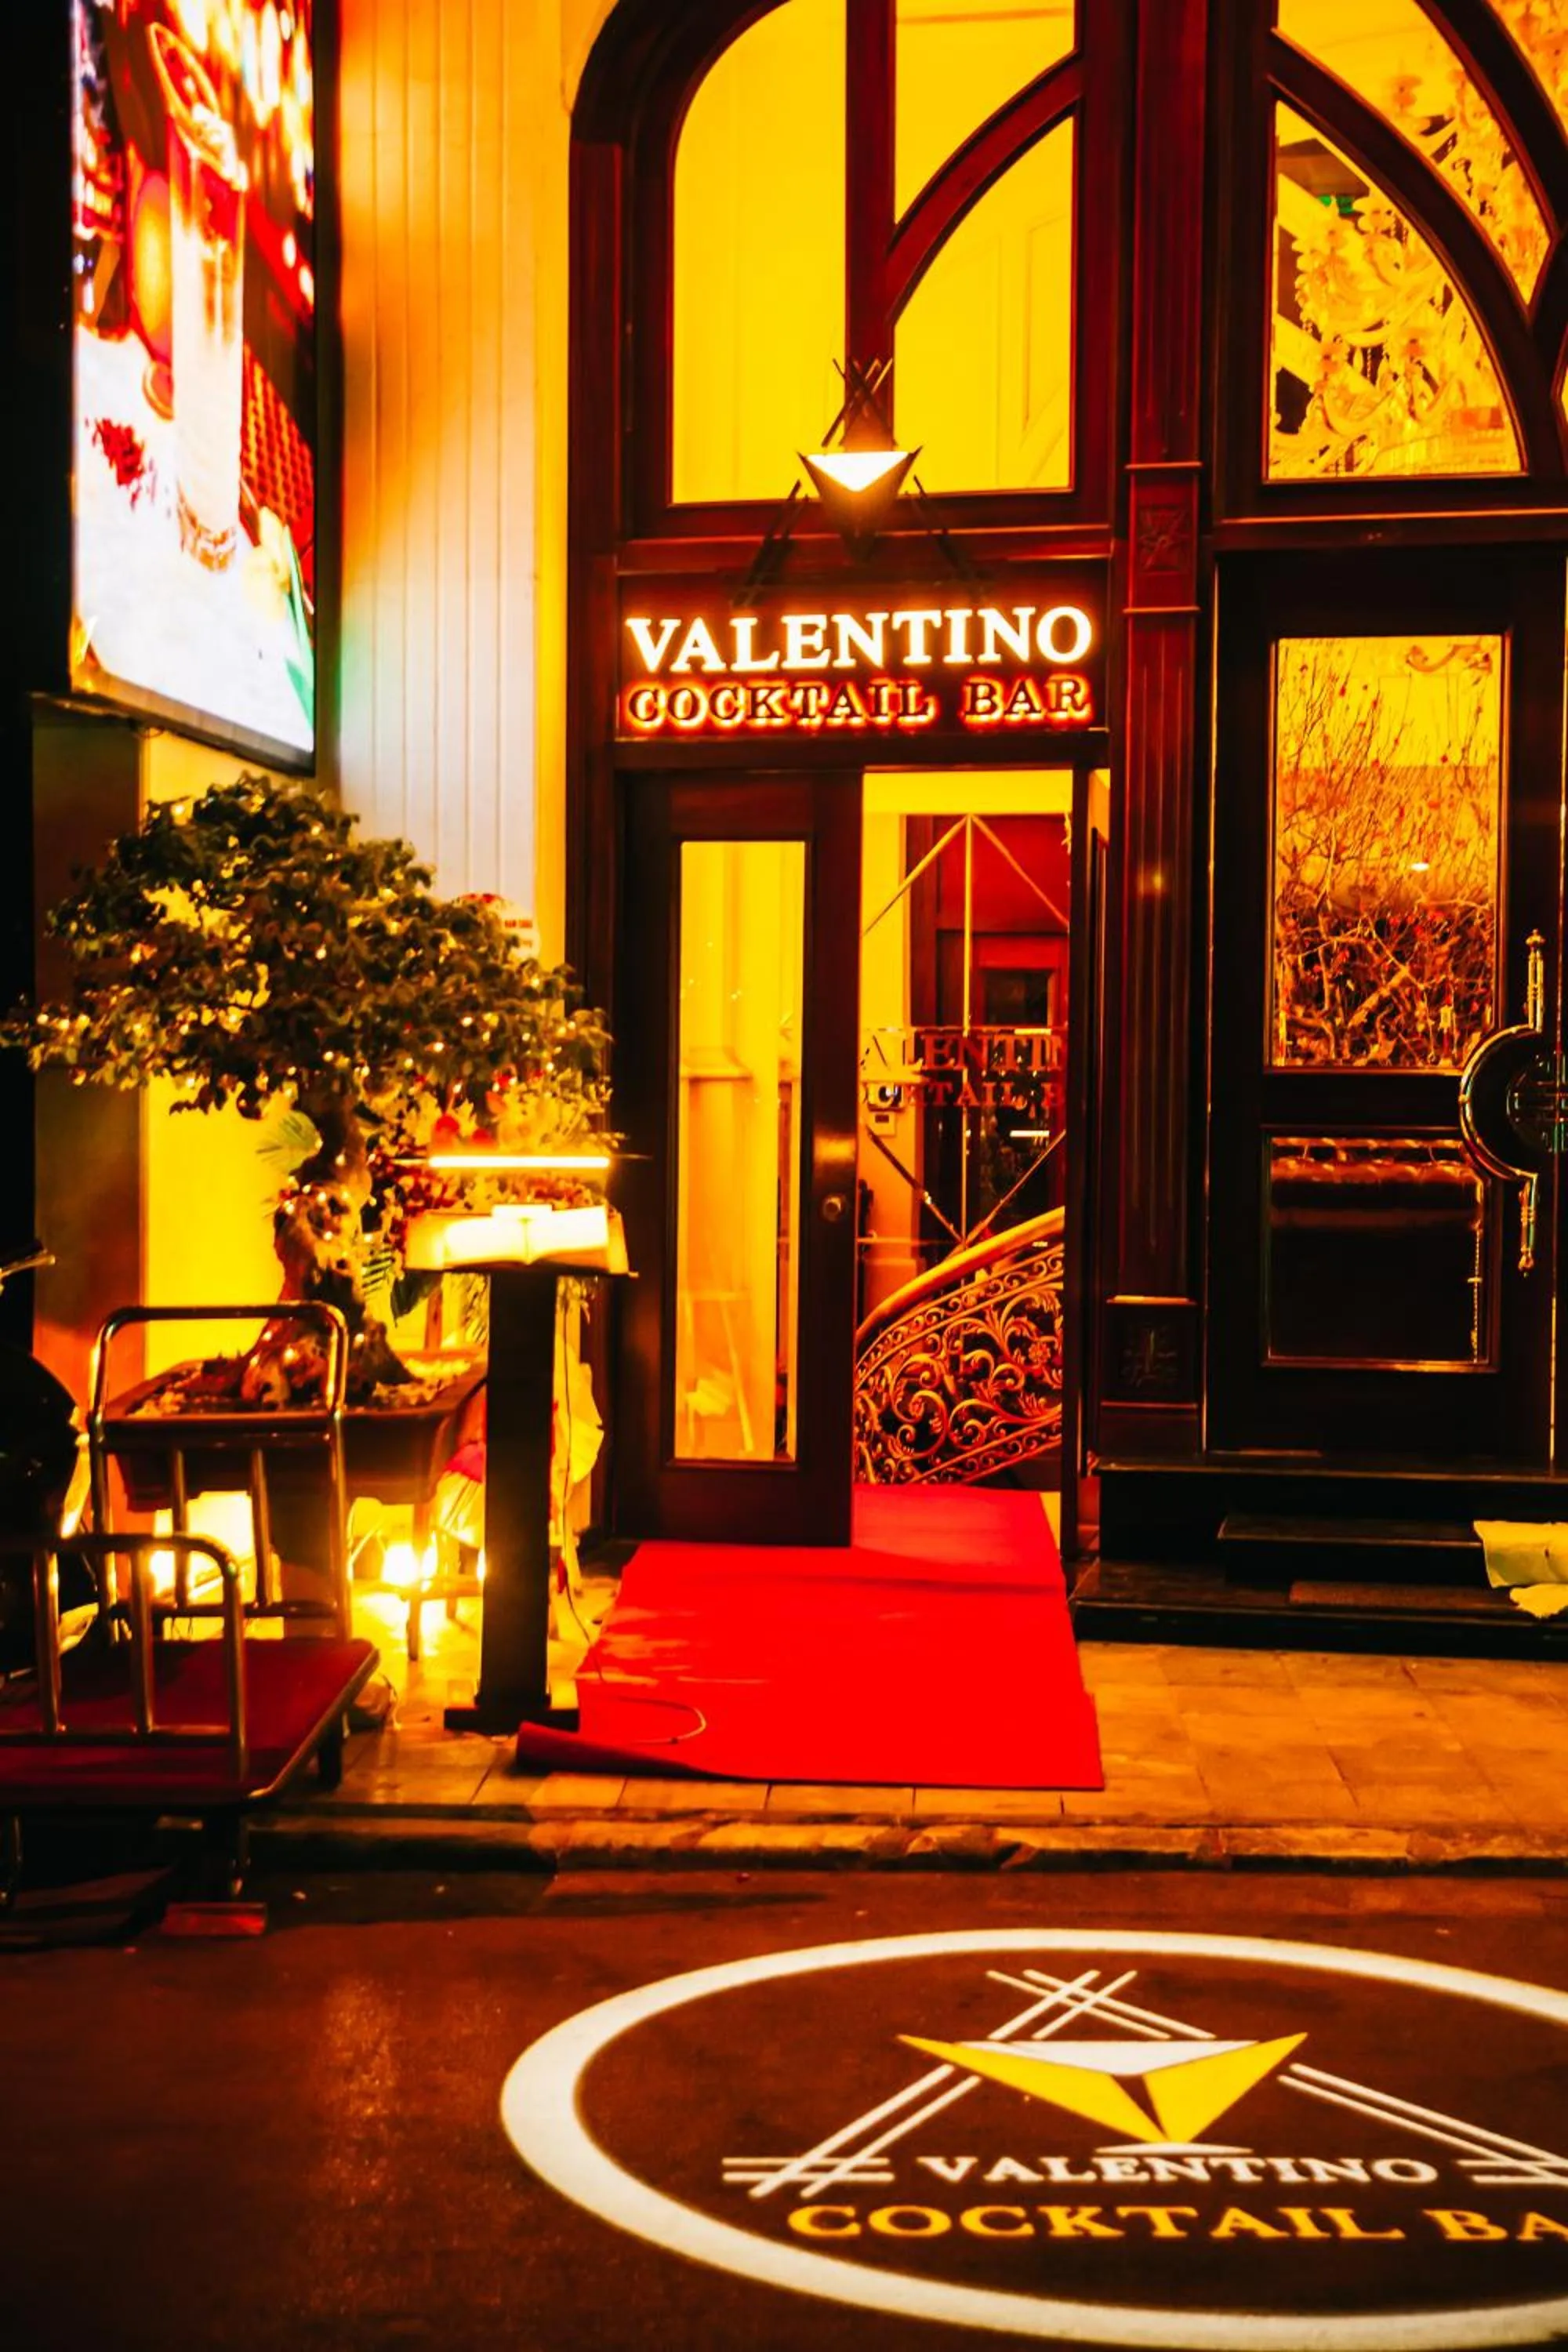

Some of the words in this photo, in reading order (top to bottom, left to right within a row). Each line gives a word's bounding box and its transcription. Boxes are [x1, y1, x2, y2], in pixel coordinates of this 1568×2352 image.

[624, 605, 1094, 673] VALENTINO
[626, 681, 934, 724] COCKTAIL
[963, 677, 1093, 719] BAR
[917, 2156, 1437, 2183] VALENTINO
[787, 2205, 1404, 2240] COCKTAIL
